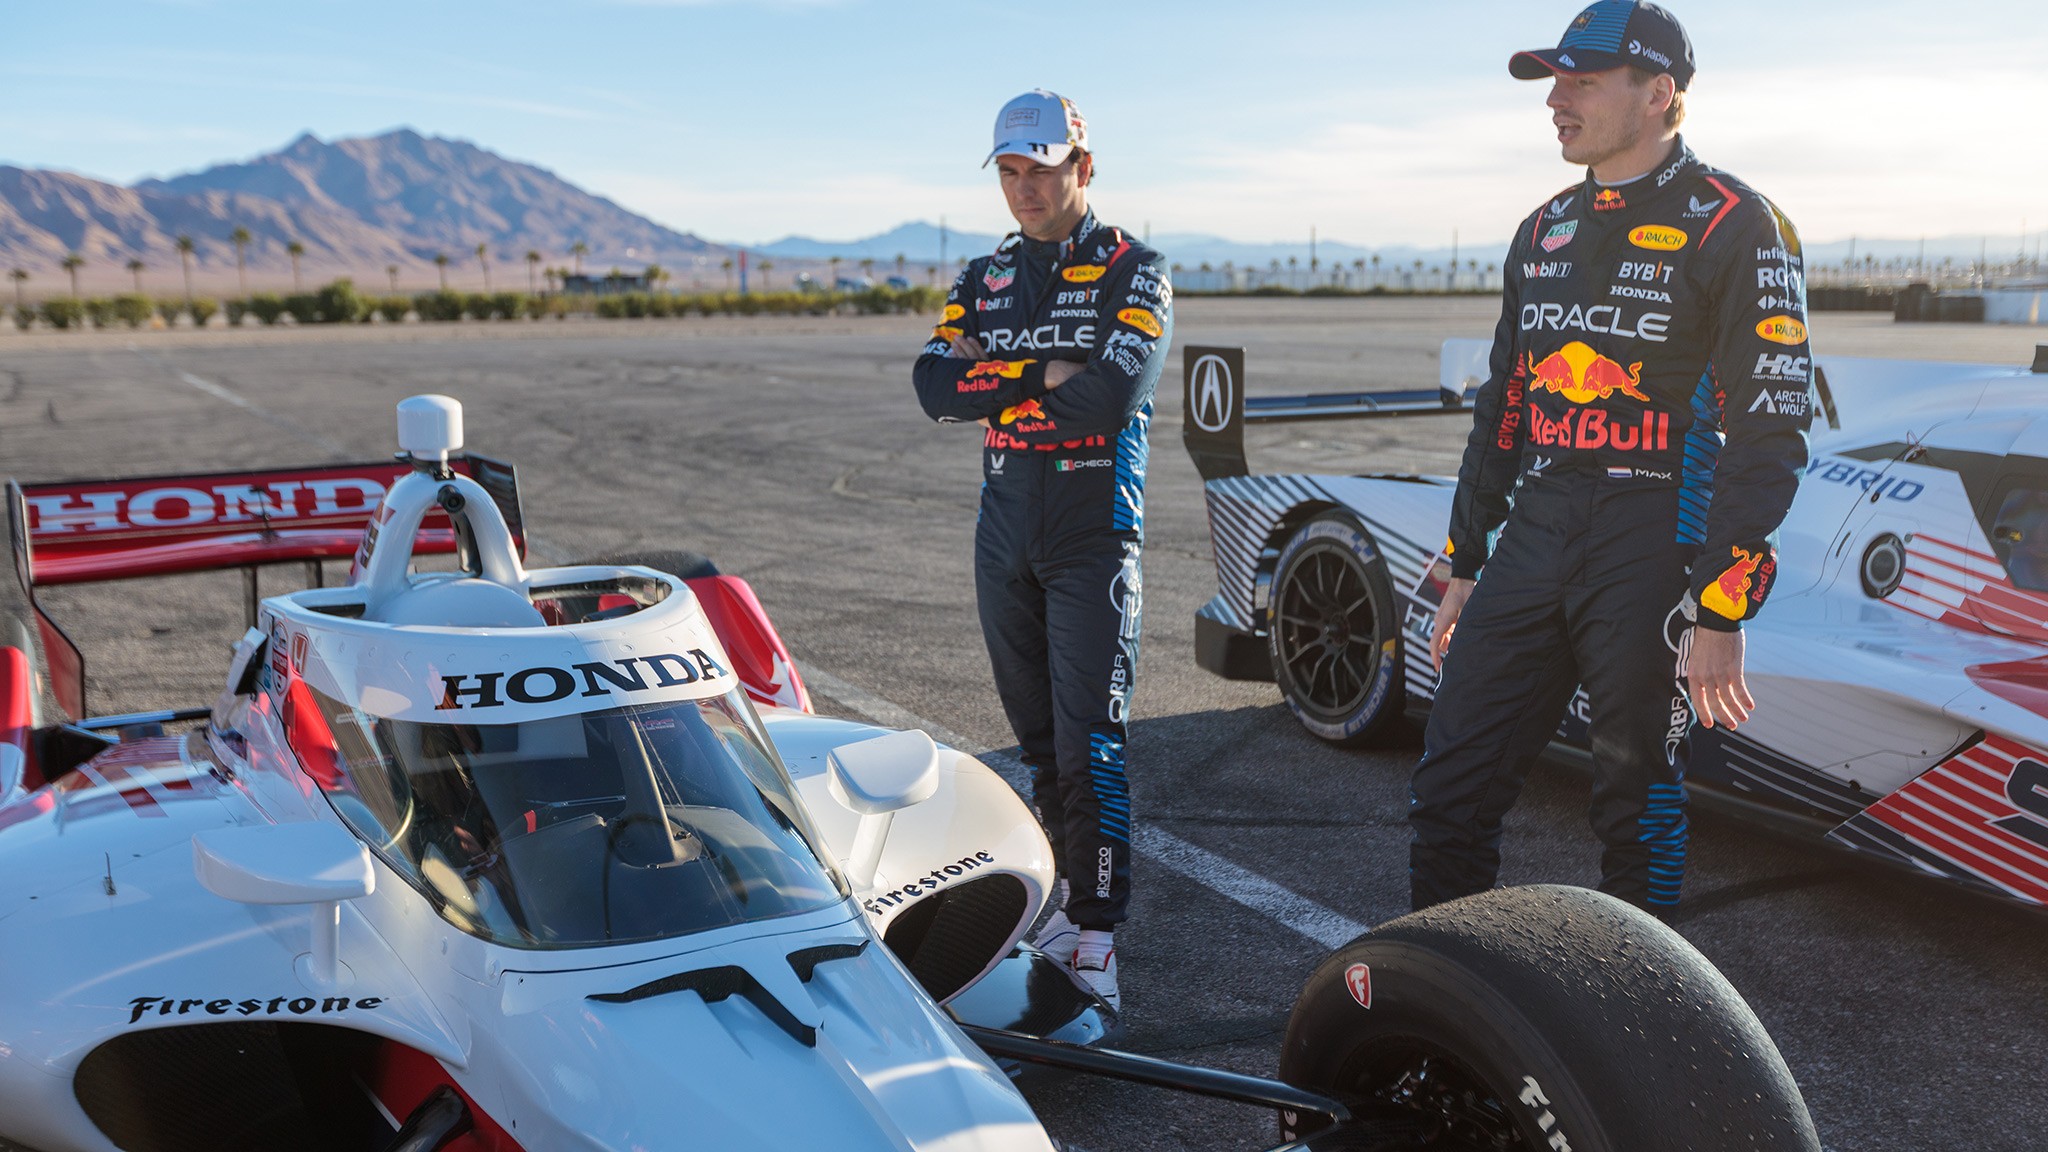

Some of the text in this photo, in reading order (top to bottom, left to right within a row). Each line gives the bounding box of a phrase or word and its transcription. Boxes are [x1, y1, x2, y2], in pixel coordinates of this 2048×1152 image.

[1642, 46, 1673, 68] viaplay
[1027, 142, 1048, 155] 11
[1593, 200, 1627, 211] Red Bull
[1552, 222, 1575, 236] TAG
[1644, 232, 1682, 246] RAUCH
[1523, 261, 1557, 278] Mobil
[1618, 261, 1674, 284] BYBIT
[1056, 287, 1099, 305] BYBIT
[1610, 285, 1673, 304] HONDA
[1050, 309, 1099, 319] HONDA
[1521, 303, 1672, 342] ORACLE
[1775, 323, 1803, 338] RAUCH
[1114, 354, 1138, 377] WOLF
[1115, 347, 1144, 374] ARCTIC
[1753, 353, 1809, 377] HRC
[957, 378, 999, 393] Red Bull
[1507, 379, 1523, 408] YOU
[1774, 389, 1809, 405] ARCTIC
[1779, 402, 1806, 417] WOLF
[1016, 420, 1057, 433] Red Bull
[1498, 411, 1520, 450] GIVES
[1528, 402, 1669, 450] Red Bull
[1073, 459, 1113, 469] CHECO
[1635, 468, 1672, 480] MAX
[1806, 458, 1925, 502] YBRID
[28, 478, 388, 534] HOND
[1752, 572, 1769, 603] Red
[435, 648, 729, 711] HONDA
[1097, 846, 1112, 898] sparco
[862, 851, 995, 916] Firestone
[128, 996, 384, 1025] Firestone
